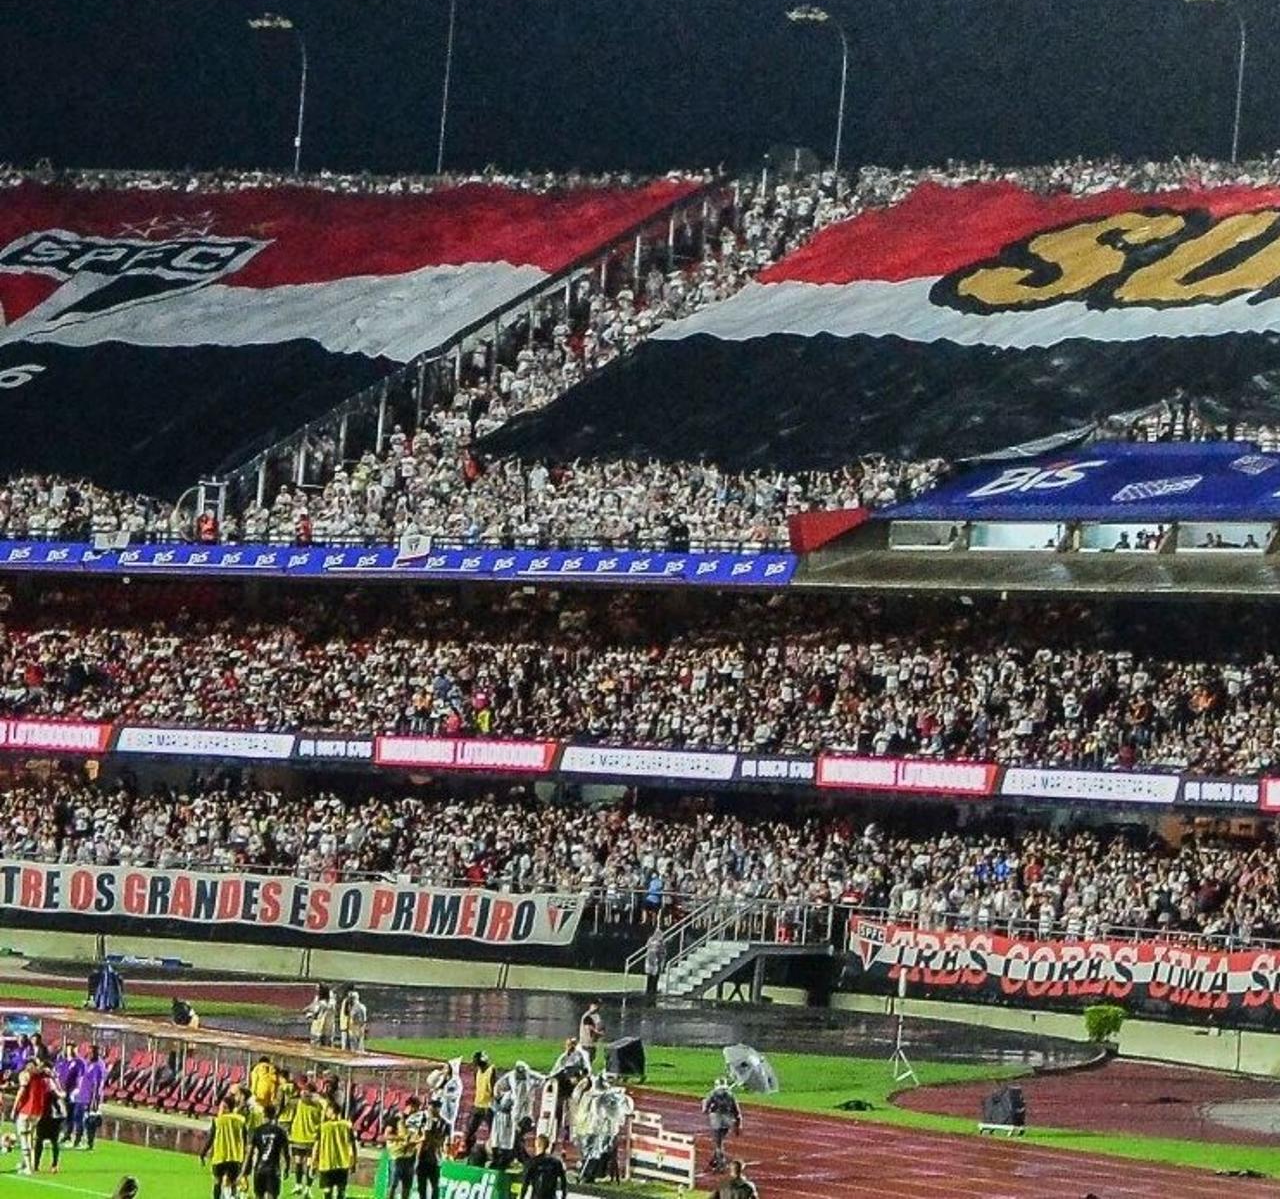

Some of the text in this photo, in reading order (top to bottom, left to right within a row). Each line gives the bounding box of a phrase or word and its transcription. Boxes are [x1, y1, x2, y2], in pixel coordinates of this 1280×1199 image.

[20, 240, 236, 270] SPFC
[0, 866, 60, 909] TRE
[70, 871, 115, 913] OS
[123, 872, 282, 925] GRANDES
[338, 888, 362, 929] O
[370, 884, 534, 942] PRIMEIRO
[859, 923, 885, 943] SPFC
[1000, 943, 1139, 999] CORES
[1147, 946, 1231, 1009] UMA
[262, 1134, 276, 1161] 7
